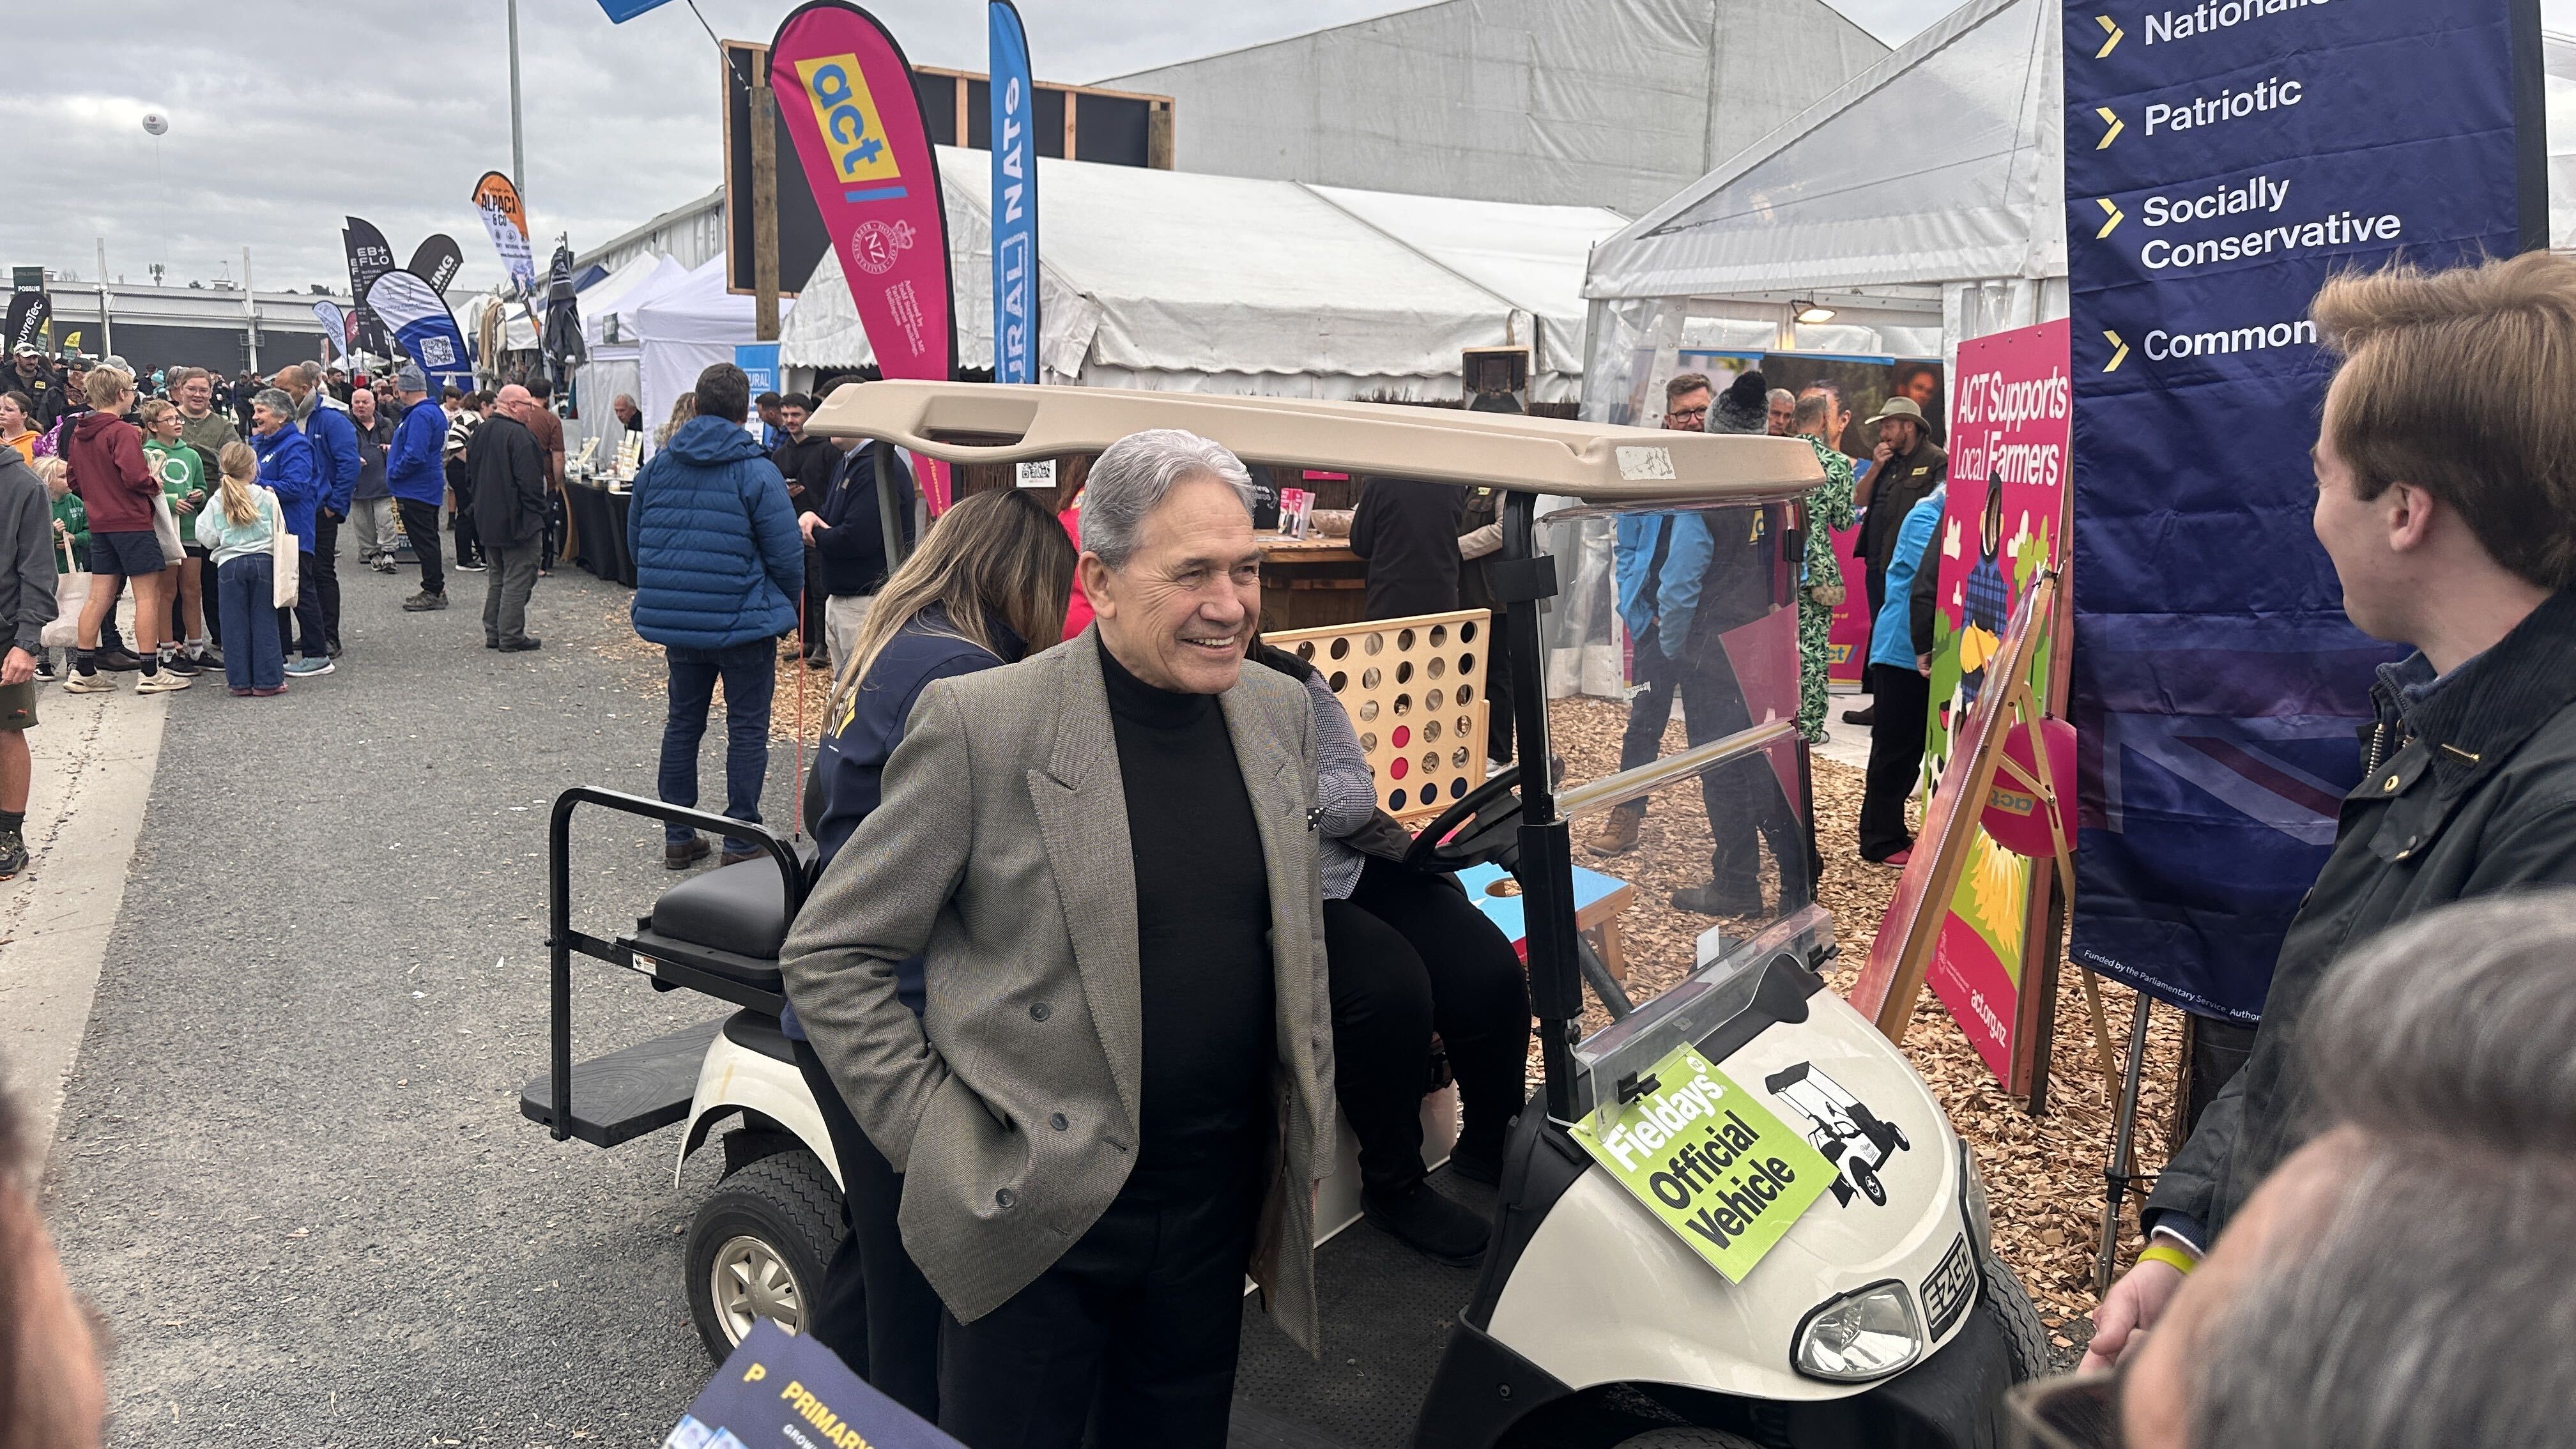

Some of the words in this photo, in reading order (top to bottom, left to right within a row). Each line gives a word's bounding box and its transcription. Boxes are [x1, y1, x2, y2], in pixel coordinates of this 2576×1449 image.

[2145, 0, 2335, 45] Nationa
[813, 64, 883, 175] act
[2145, 77, 2302, 136] Patriotic
[1002, 77, 1023, 224] NATS
[2142, 175, 2290, 227] Socially
[359, 255, 389, 266] FLO
[865, 231, 886, 264] NZ
[2141, 211, 2401, 270] Conservative
[885, 287, 901, 327] Wellington
[898, 281, 909, 301] Todd
[2143, 319, 2317, 361] Common
[1957, 373, 1990, 424] ACT
[1988, 366, 2068, 433] Supports
[1954, 429, 1988, 480] Local
[1986, 431, 2059, 486] Farmers
[1991, 790, 2032, 811] act
[2084, 949, 2115, 967] Funded
[2115, 961, 2126, 972] by
[2126, 966, 2139, 977] the
[2139, 971, 2196, 1001] Parliamentary
[1970, 988, 2007, 1048] act.org.nz
[1650, 1109, 1760, 1209] Official
[1685, 1157, 1795, 1250] Vehicle
